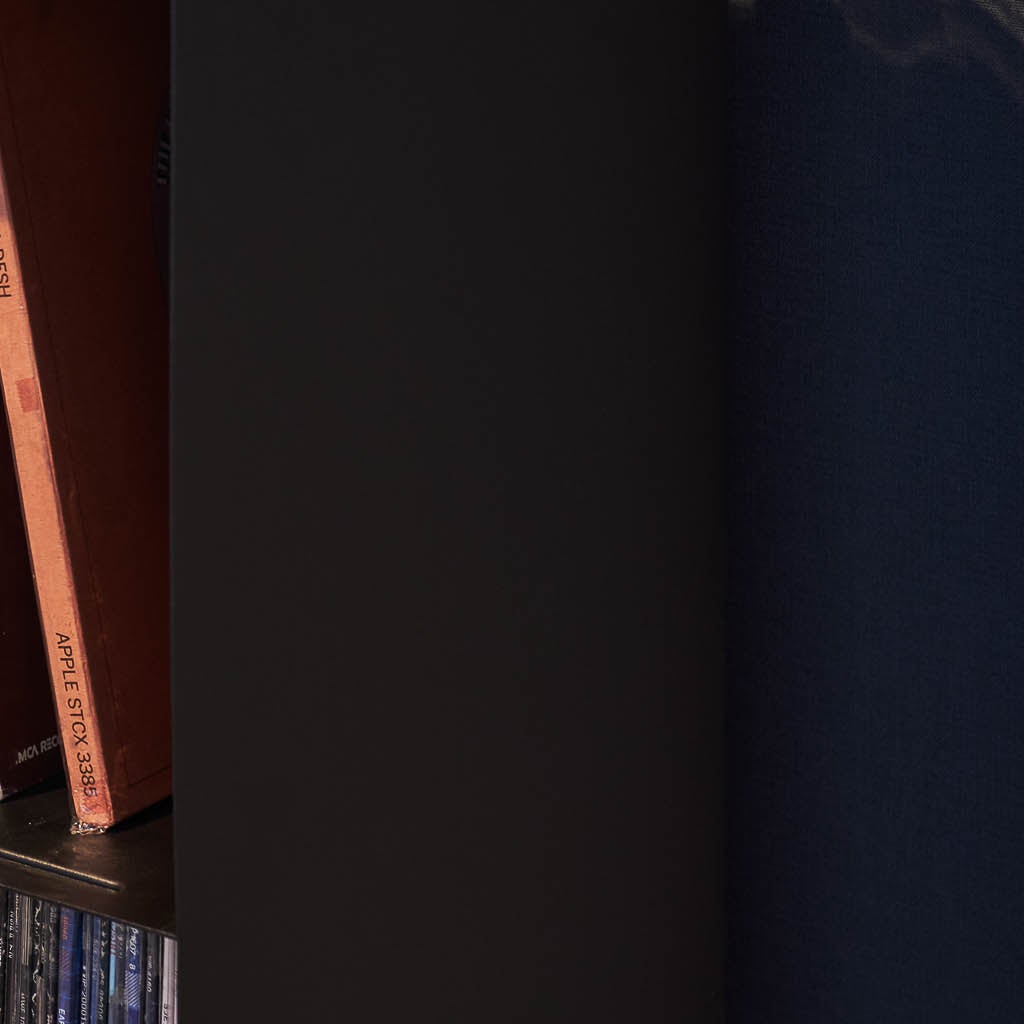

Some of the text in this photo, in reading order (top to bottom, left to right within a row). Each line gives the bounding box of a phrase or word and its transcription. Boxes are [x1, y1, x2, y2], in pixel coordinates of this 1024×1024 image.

[16, 744, 39, 765] MCA
[56, 632, 99, 799] APPLE STCX 3385
